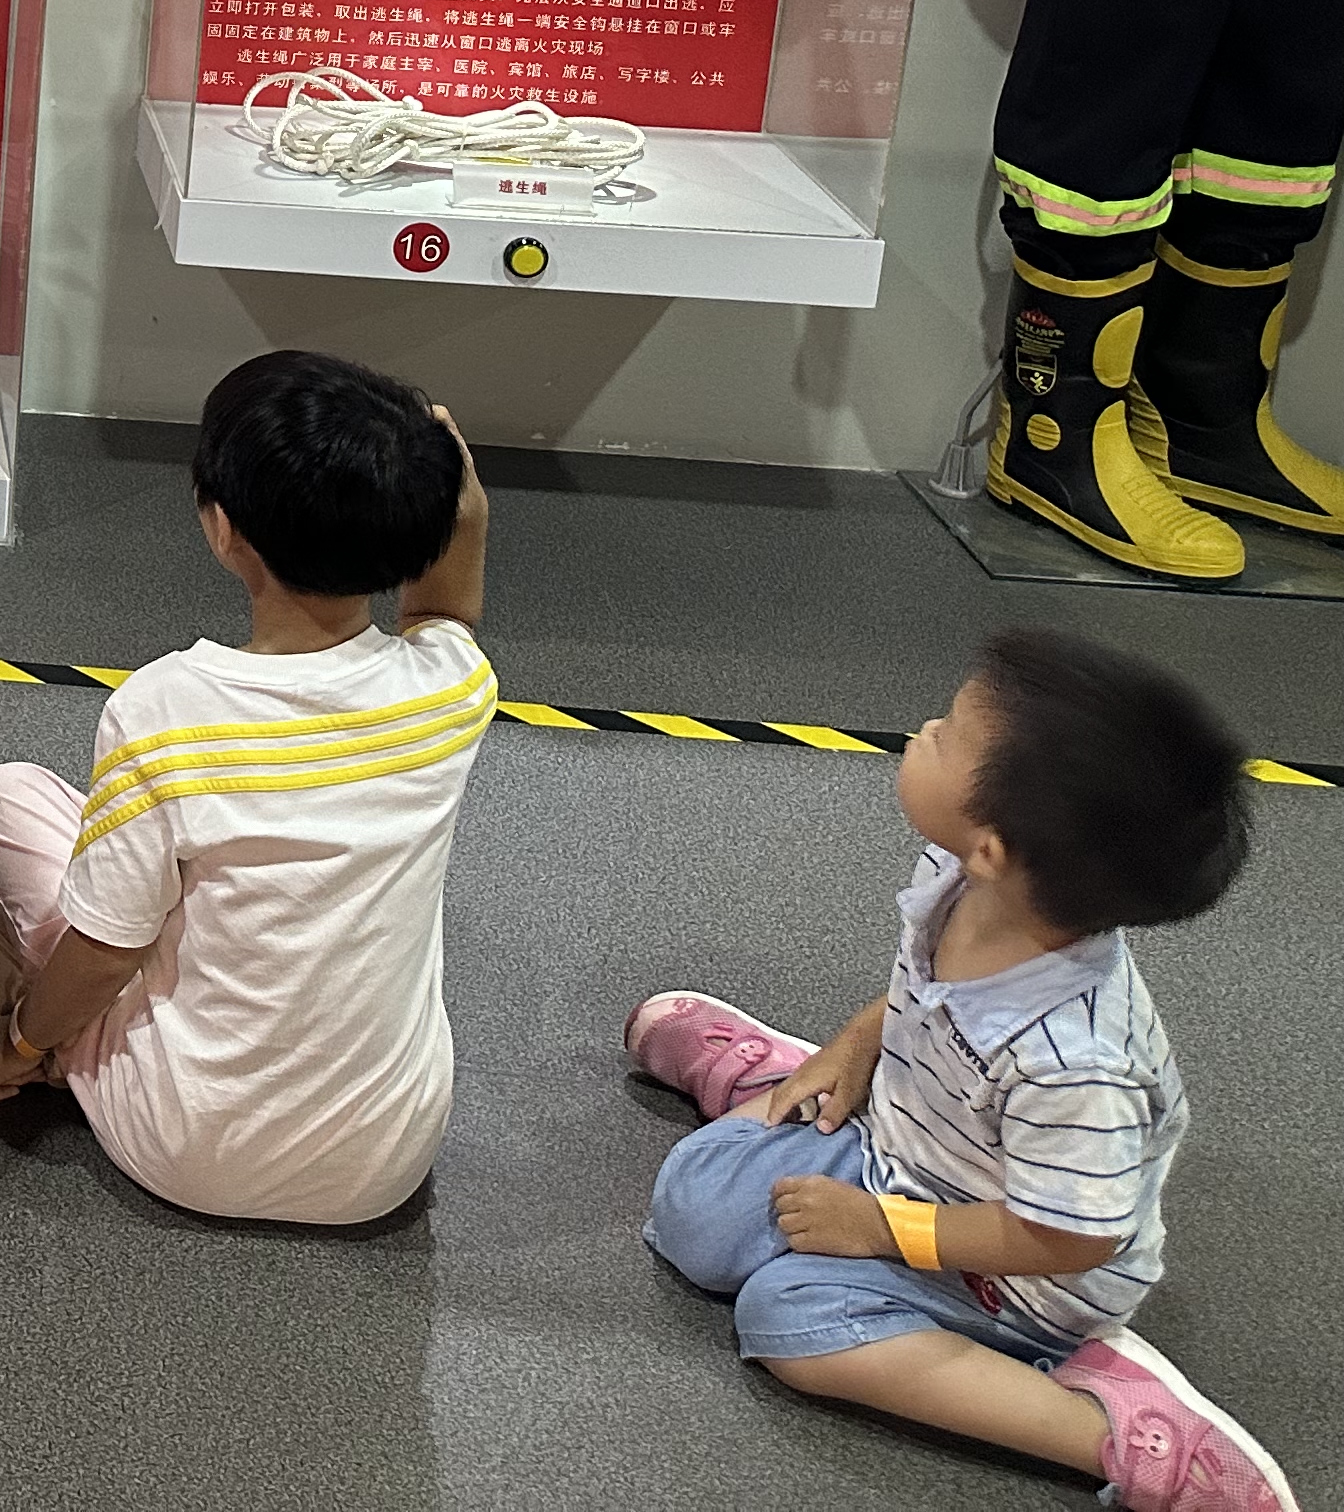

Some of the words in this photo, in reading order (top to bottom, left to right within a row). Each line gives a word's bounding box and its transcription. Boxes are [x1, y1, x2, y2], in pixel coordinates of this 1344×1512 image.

[498, 179, 547, 196] 逃生绳
[399, 233, 443, 262] 16
